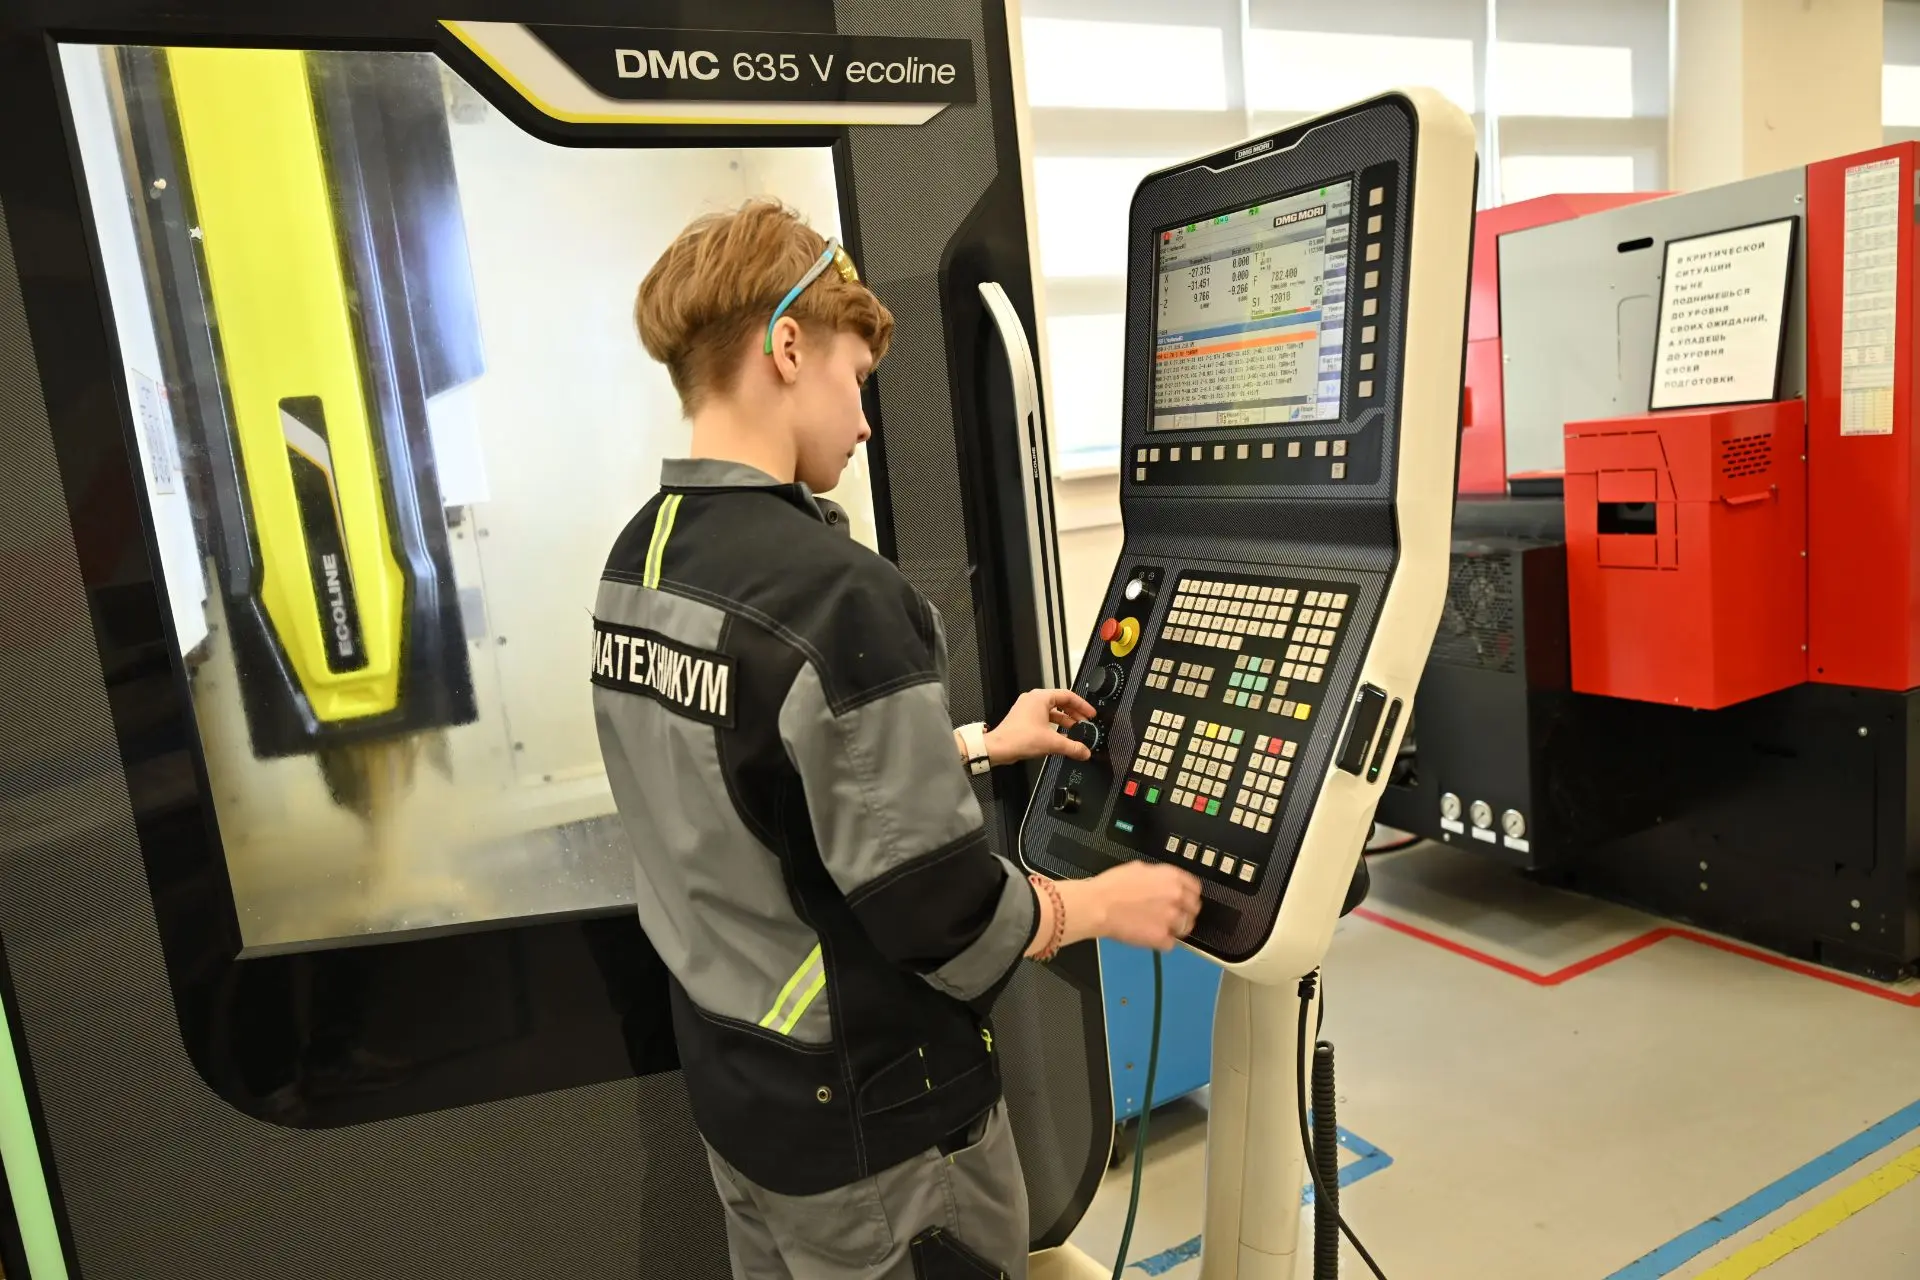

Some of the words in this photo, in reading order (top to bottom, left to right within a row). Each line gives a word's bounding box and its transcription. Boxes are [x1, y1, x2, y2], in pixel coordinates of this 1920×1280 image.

[615, 48, 720, 80] DMC
[732, 53, 800, 82] 635
[809, 54, 834, 82] V
[846, 56, 956, 85] ecoline
[1238, 149, 1252, 158] DMG
[1253, 142, 1270, 153] MORI
[1275, 213, 1297, 226] DMG
[1298, 206, 1324, 220] MORI
[1686, 241, 1765, 262] КРИТИЧЕСКОЙ
[1188, 265, 1211, 278] -27.315
[1675, 262, 1731, 278] СИТУАЦИИ
[1187, 278, 1210, 291] -31.451
[1227, 283, 1249, 295] -9.266
[1674, 284, 1687, 292] ТЫ
[1690, 281, 1703, 289] НЕ
[1672, 288, 1750, 306] ПОДНИМЕШЬСЯ
[1671, 312, 1685, 320] ДО
[1687, 305, 1729, 317] УРОВНЯ
[1670, 322, 1704, 334] СВОИХ
[1678, 334, 1726, 346] УПАДЕШЬ
[1667, 353, 1680, 362] ДО
[1683, 348, 1724, 359] УРОВНЯ
[1665, 364, 1700, 375] СВОЕЙ
[322, 553, 353, 657] ECOLINE
